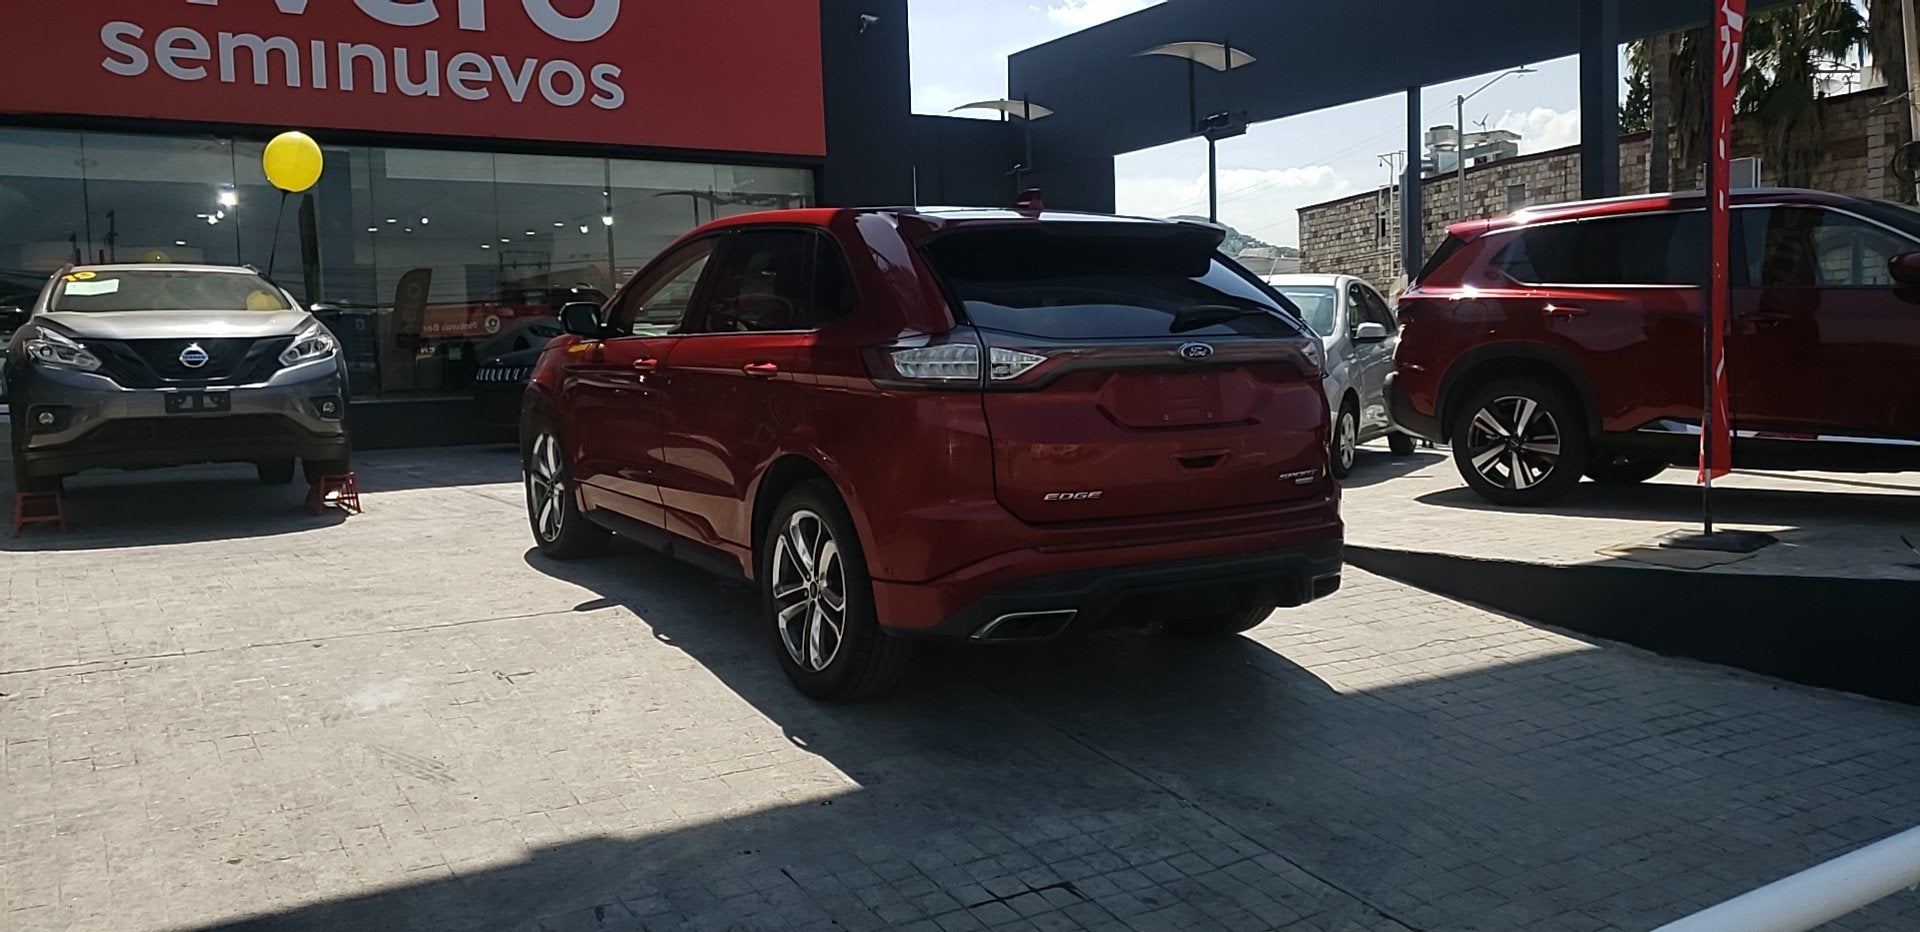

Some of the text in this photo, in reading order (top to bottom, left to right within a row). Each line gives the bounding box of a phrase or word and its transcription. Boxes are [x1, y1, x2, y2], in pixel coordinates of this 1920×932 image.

[99, 20, 625, 110] seminuevos
[1189, 347, 1207, 357] Ford
[1043, 490, 1103, 501] EDGE
